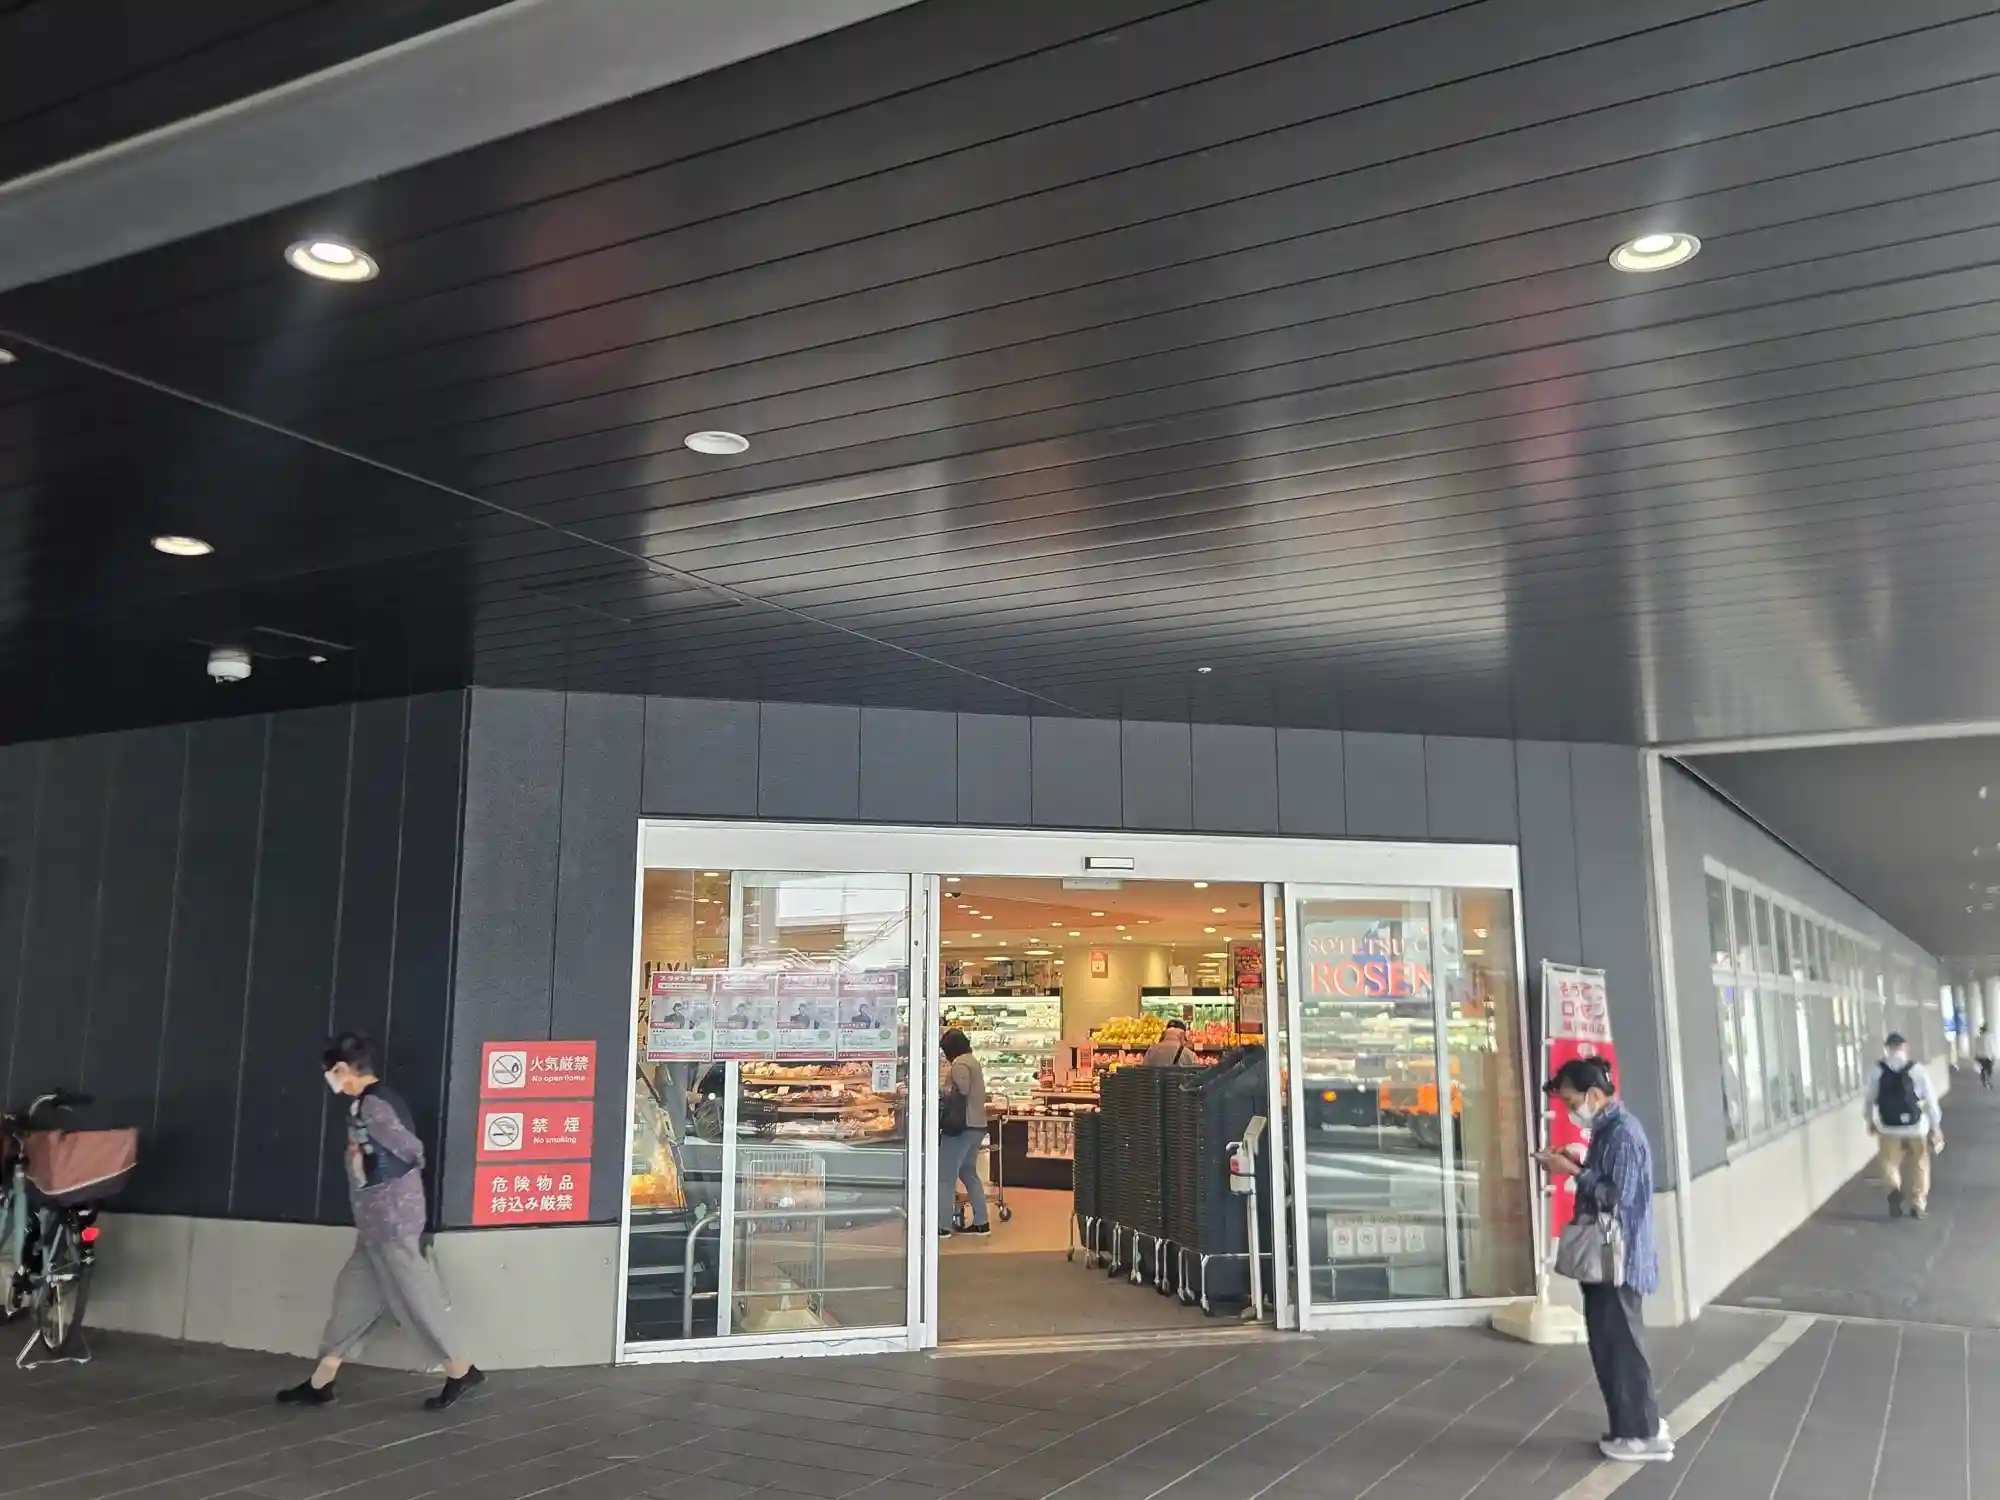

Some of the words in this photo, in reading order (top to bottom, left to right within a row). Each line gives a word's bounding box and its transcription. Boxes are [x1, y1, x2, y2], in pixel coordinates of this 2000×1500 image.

[1309, 961, 1433, 997] ROSEN
[530, 1056, 589, 1072] 火気厳禁
[532, 1116, 581, 1133] 禁煙
[533, 1136, 544, 1144] No
[546, 1136, 577, 1144] smoking
[492, 1174, 574, 1192] 危険物品
[491, 1194, 573, 1213] 持込み厳禁
